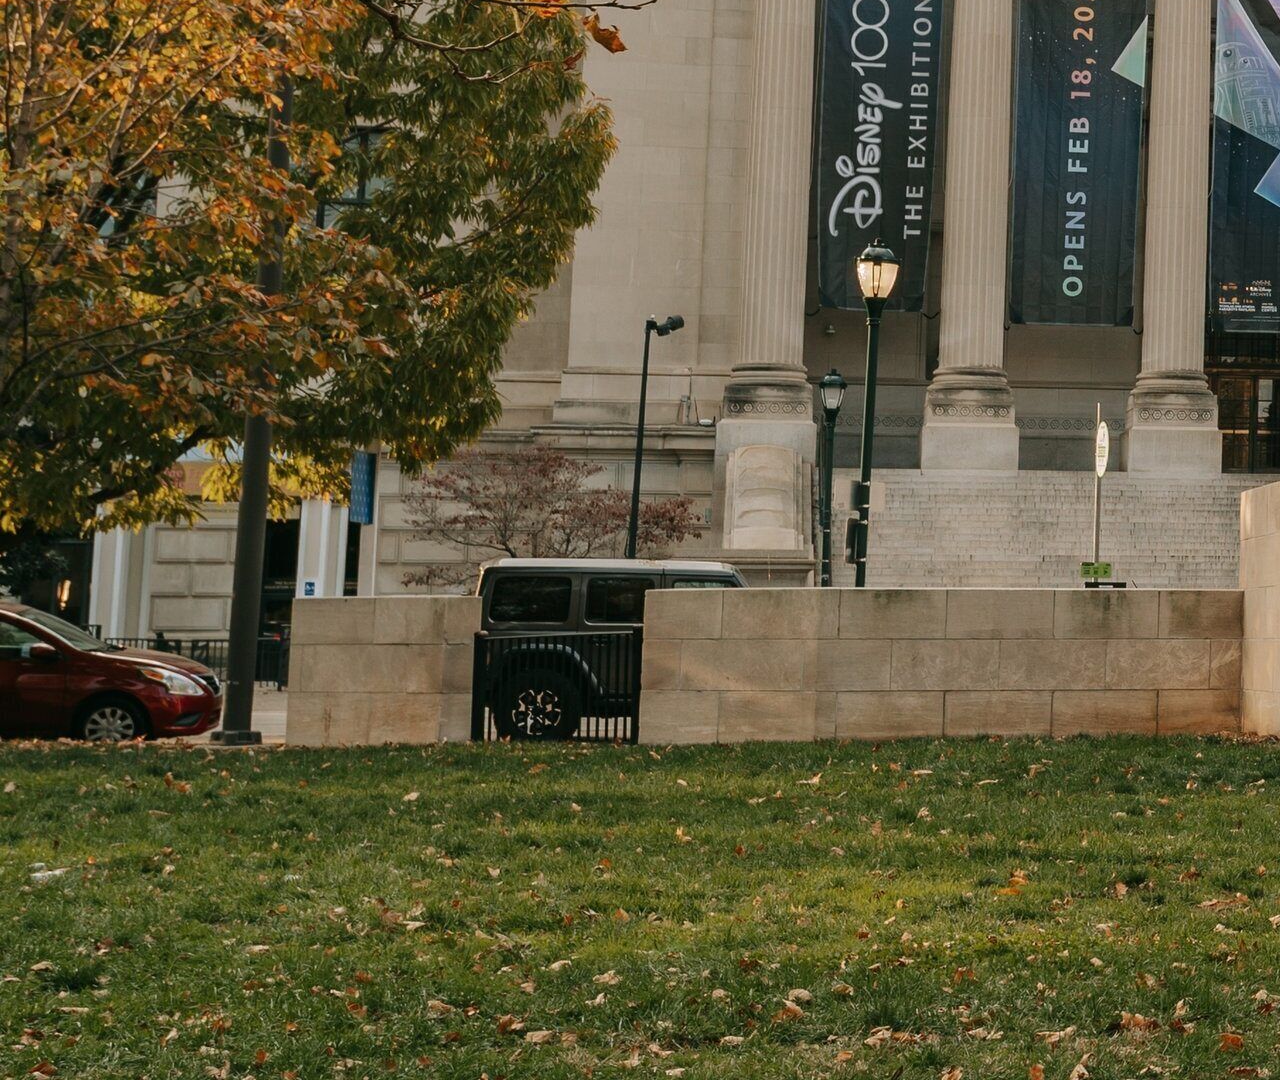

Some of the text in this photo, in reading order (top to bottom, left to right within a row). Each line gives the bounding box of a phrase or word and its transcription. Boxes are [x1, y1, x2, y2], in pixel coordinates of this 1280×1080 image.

[1070, 57, 1097, 100] 18,
[1067, 116, 1090, 174] FEB
[903, 184, 925, 240] THE
[1061, 190, 1087, 298] OPENS
